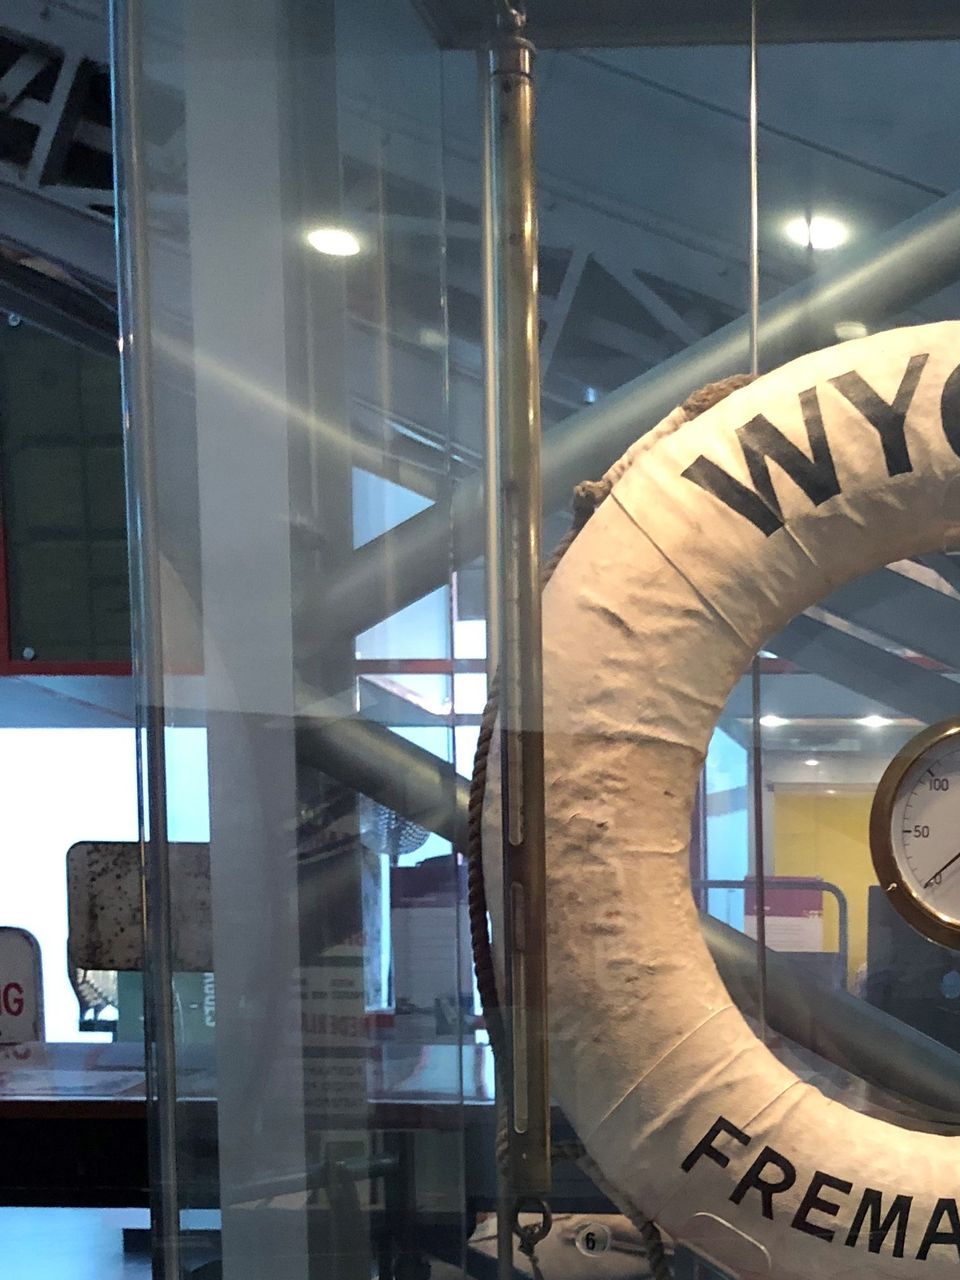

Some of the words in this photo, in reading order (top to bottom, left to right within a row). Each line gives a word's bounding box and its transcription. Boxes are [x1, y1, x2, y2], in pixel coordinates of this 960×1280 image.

[929, 778, 950, 792] 100
[913, 825, 930, 838] 50
[585, 1231, 596, 1251] 6
